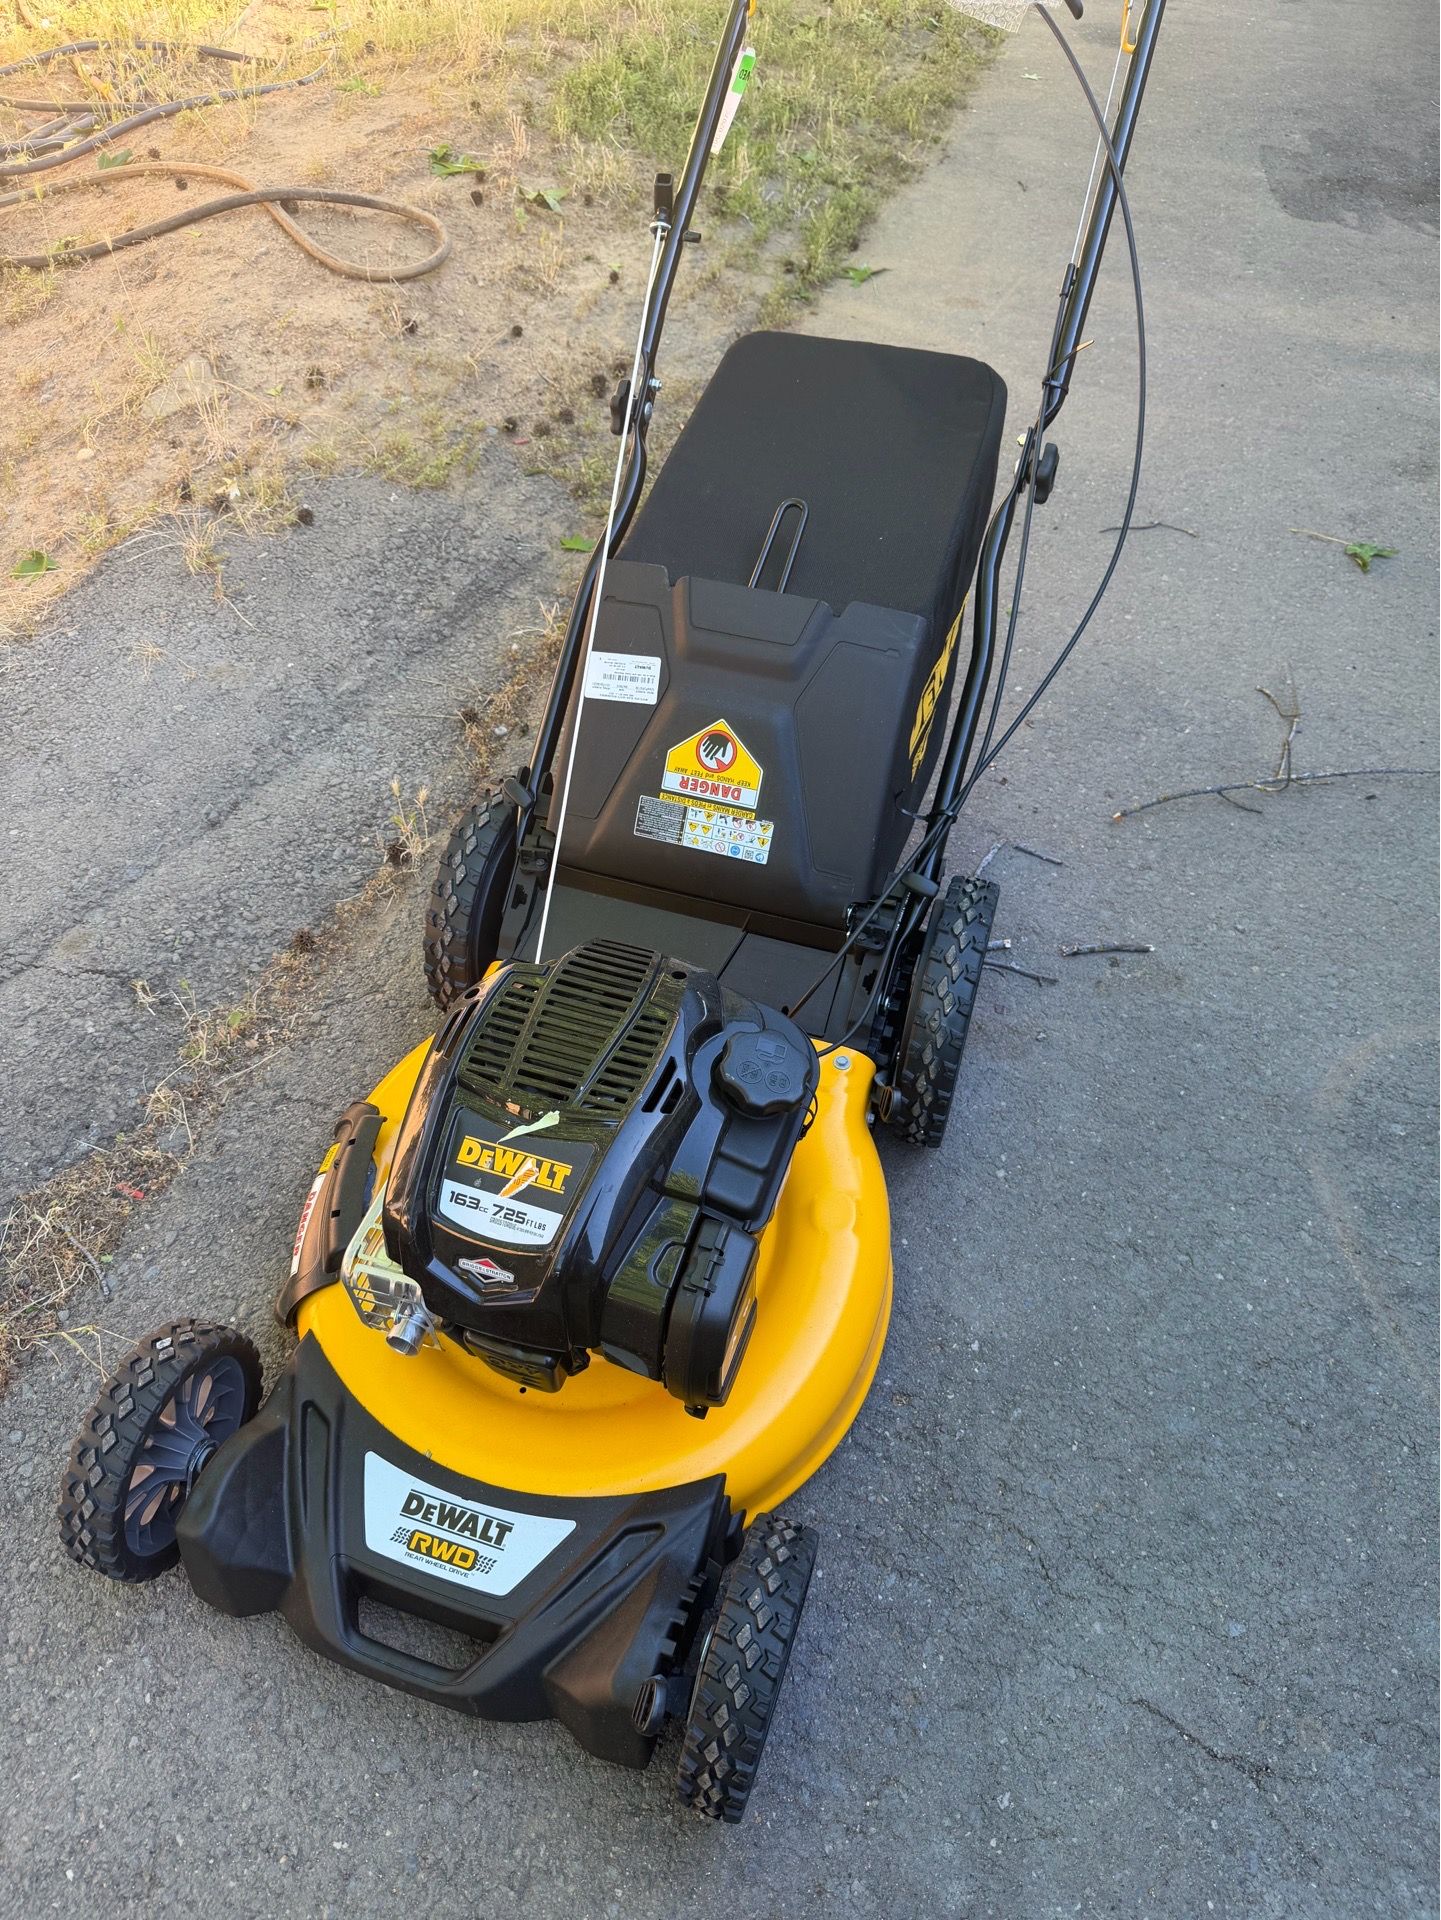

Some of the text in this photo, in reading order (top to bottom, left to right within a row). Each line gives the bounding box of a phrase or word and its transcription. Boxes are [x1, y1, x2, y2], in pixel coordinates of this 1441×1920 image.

[690, 769, 703, 779] FEET
[705, 772, 715, 780] and
[717, 774, 735, 784] HANDS
[737, 777, 751, 787] KEEP
[678, 776, 742, 801] DANGER
[661, 793, 687, 805] DISTANCE
[690, 799, 707, 810] PIEDS
[712, 806, 730, 814] MAINS
[491, 1203, 528, 1225] 7.25
[525, 1219, 533, 1227] FT
[533, 1221, 547, 1231] LBS
[293, 1190, 318, 1257] DANGER
[408, 1531, 476, 1568] RWD
[404, 1551, 470, 1579] REAR WHEEL DRIVE
